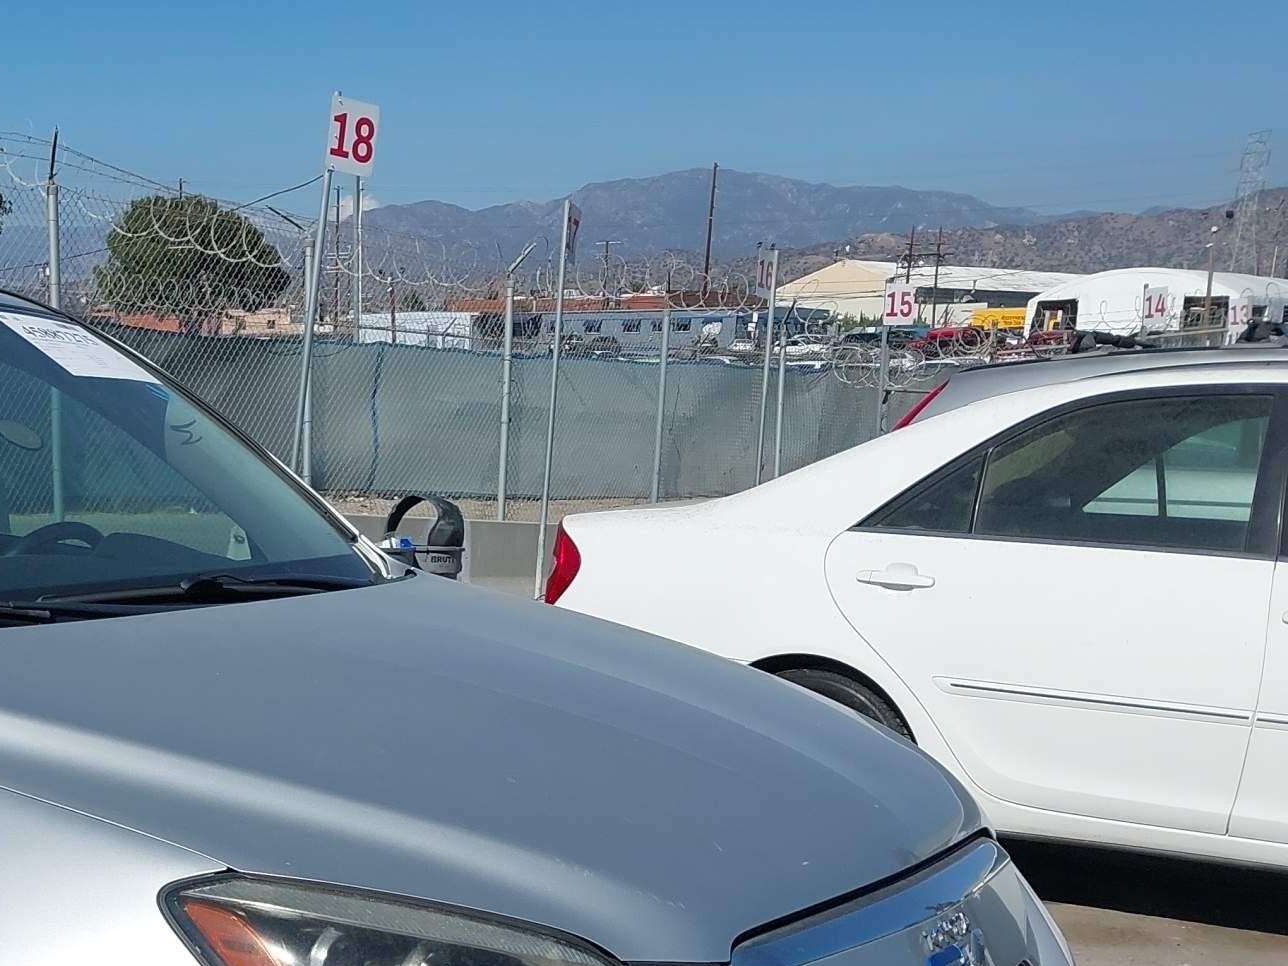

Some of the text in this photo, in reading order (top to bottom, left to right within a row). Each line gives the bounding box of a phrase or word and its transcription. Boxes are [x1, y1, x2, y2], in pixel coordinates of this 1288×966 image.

[330, 112, 375, 164] 18
[757, 259, 774, 291] 16
[885, 291, 912, 318] 15
[1144, 293, 1168, 319] 14
